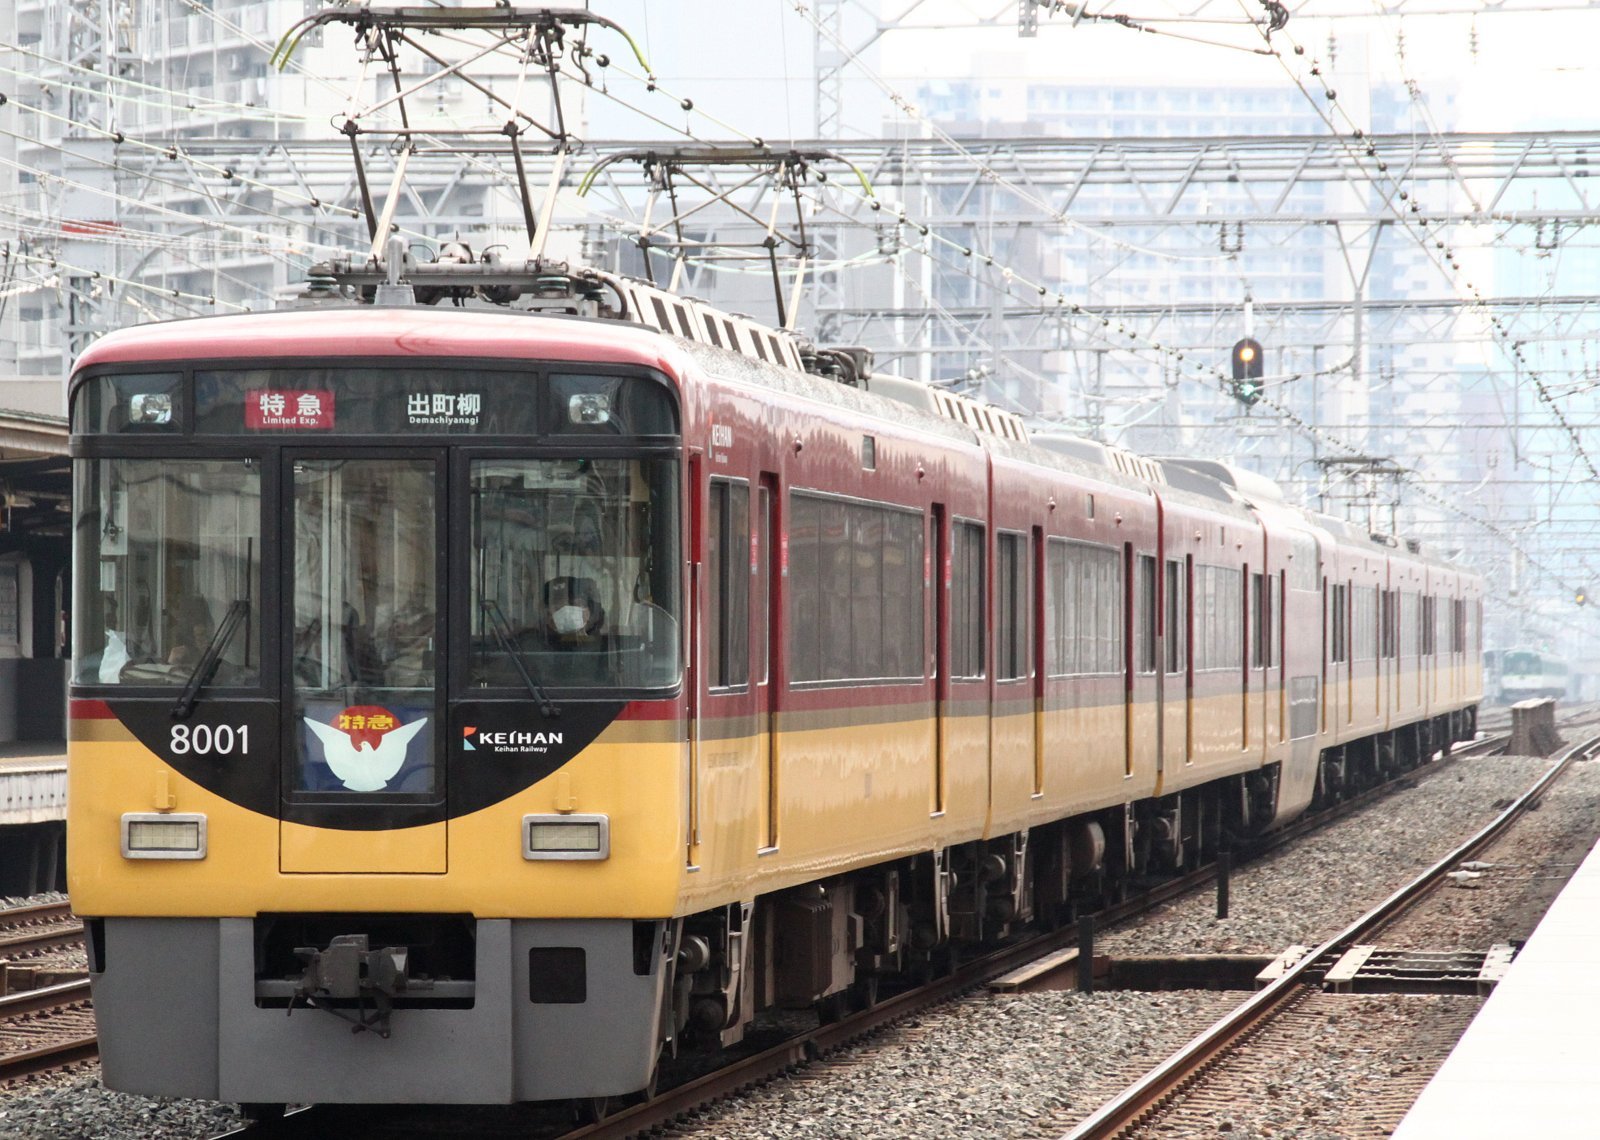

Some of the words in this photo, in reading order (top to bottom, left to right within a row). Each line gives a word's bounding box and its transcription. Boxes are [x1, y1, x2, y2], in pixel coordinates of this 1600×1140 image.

[259, 393, 322, 416] 特急
[407, 393, 481, 416] 出町柳
[262, 416, 297, 424] Limited
[299, 416, 319, 427] Exp.
[409, 415, 479, 426] Demachiyanagi
[339, 714, 393, 730] 特急
[170, 724, 248, 755] 8001
[479, 730, 563, 745] KEIHAN
[494, 745, 519, 753] Keihan
[520, 745, 548, 754] Railway
